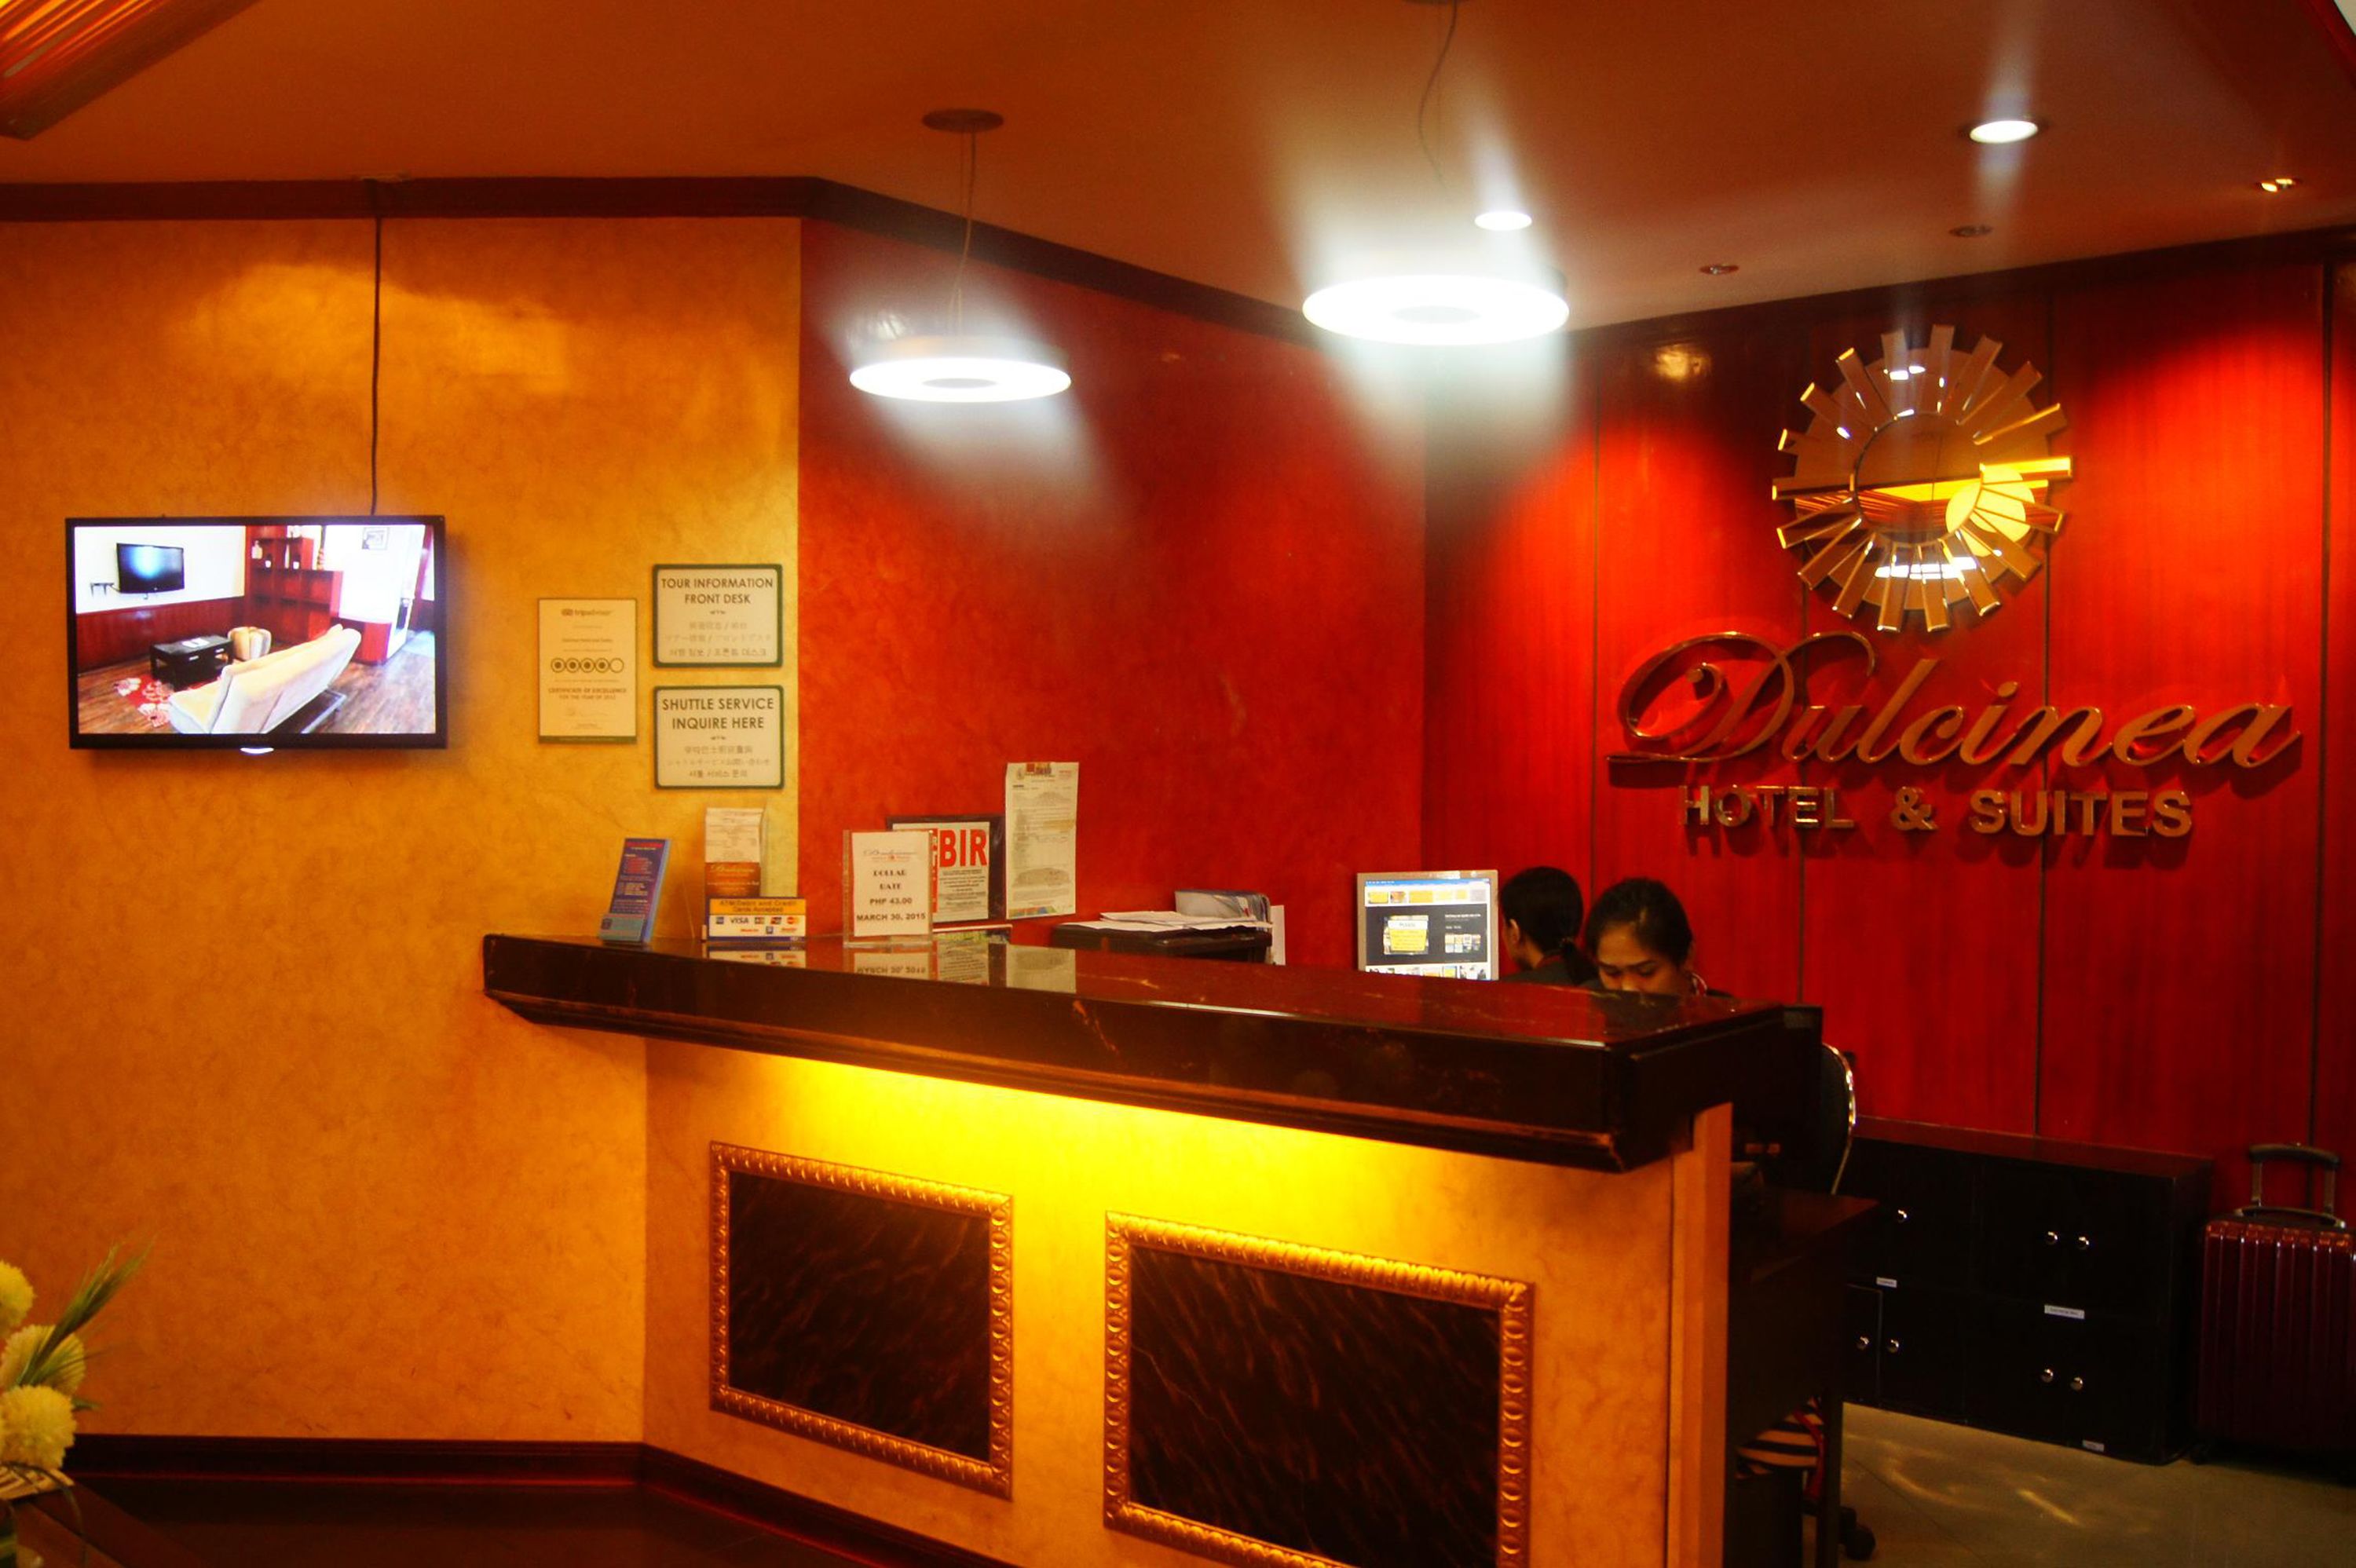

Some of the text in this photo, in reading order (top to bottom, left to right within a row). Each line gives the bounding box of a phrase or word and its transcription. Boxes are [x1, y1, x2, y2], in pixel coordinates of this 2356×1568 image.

[662, 578, 774, 589] TOUR INFORMATION
[684, 594, 751, 604] FRONT DESK
[662, 697, 774, 711] SHUTTLE SERVICE
[1606, 630, 2302, 769] Dulcinea
[672, 716, 764, 729] INQUIRE HERE
[1678, 784, 2192, 837] HOTEL & SUITES
[939, 829, 987, 868] BIR
